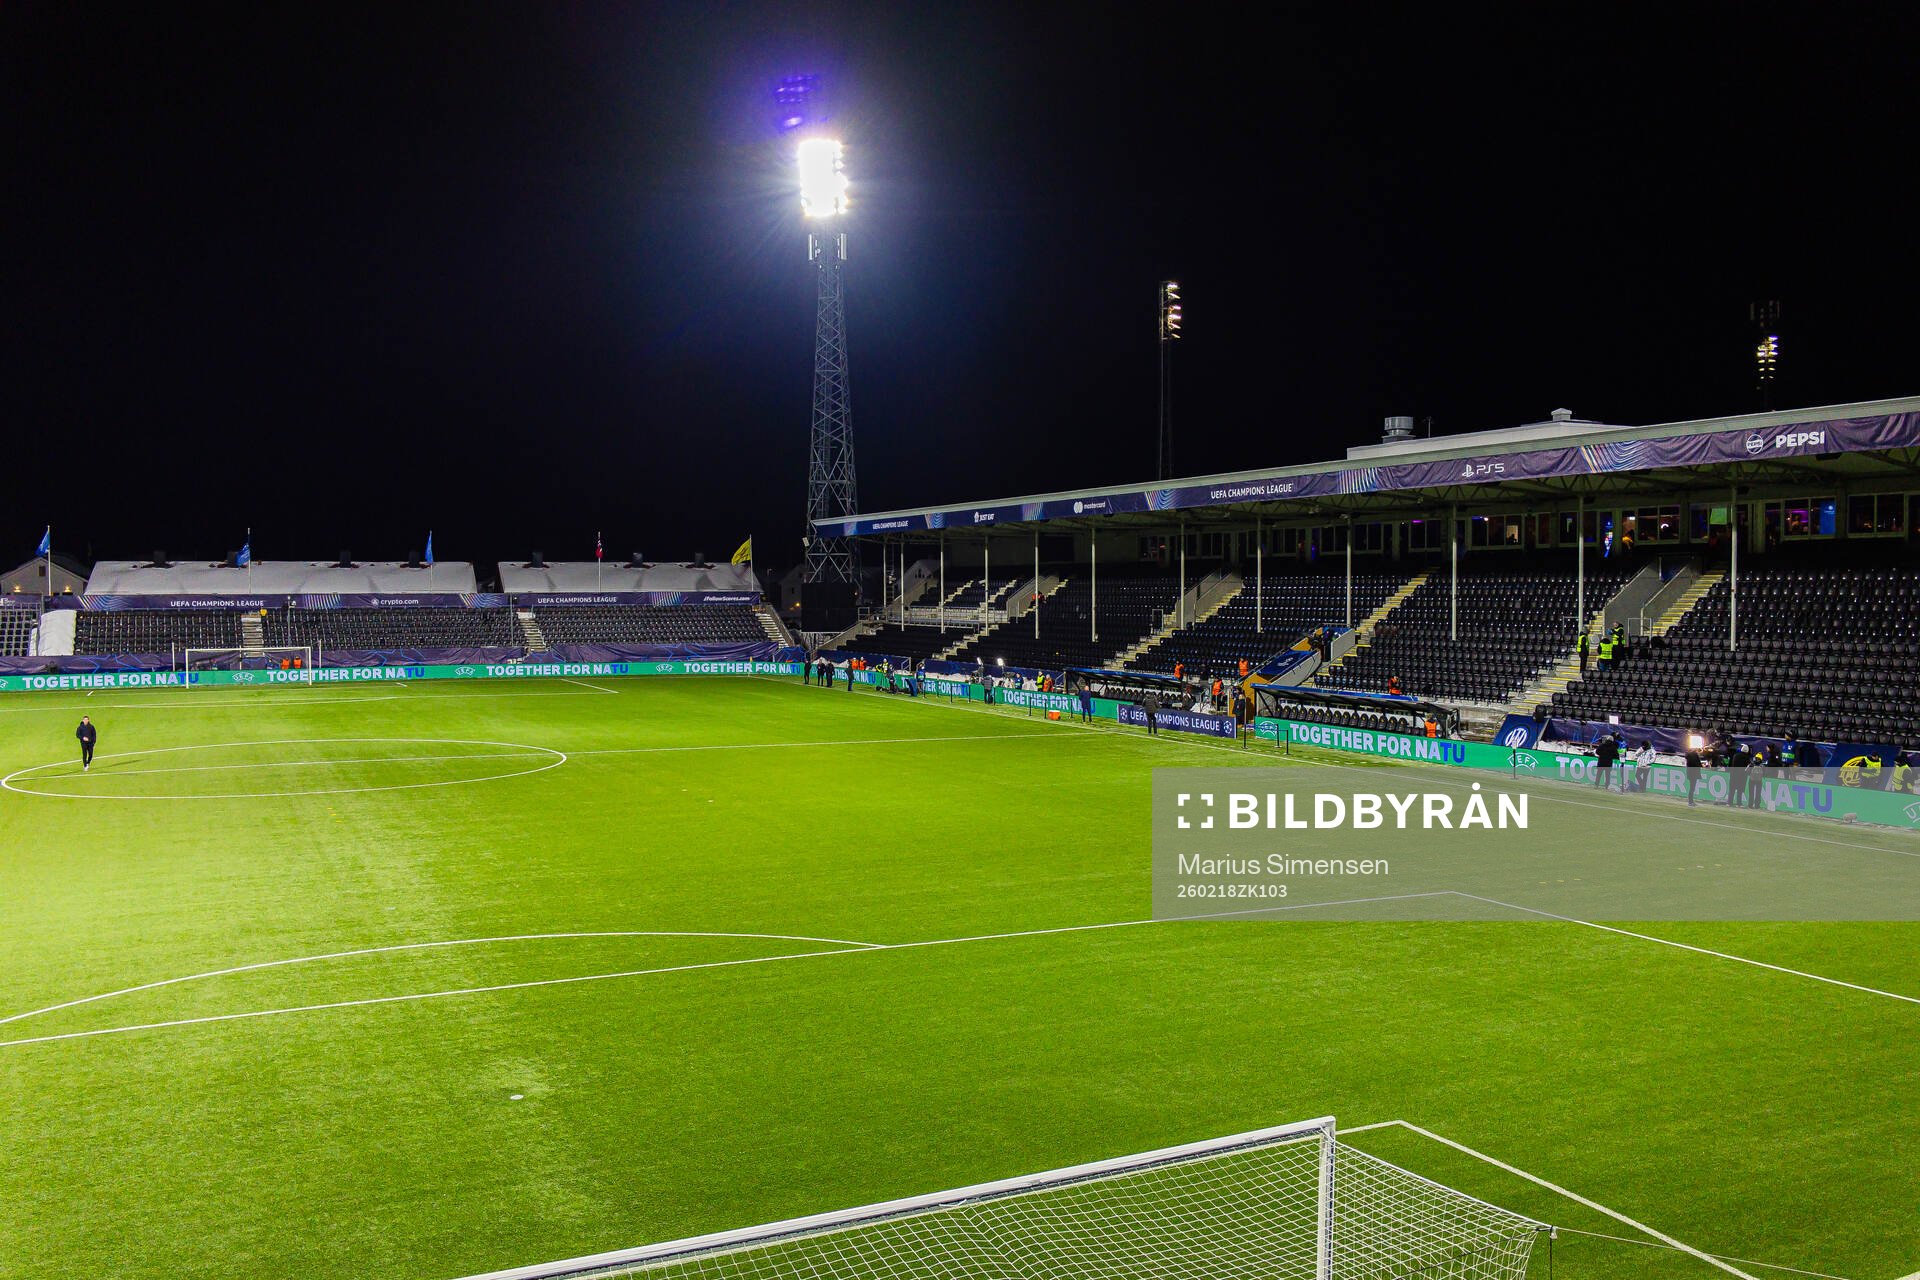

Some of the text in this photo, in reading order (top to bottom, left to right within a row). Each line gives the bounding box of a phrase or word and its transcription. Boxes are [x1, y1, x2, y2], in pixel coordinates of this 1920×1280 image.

[1776, 431, 1825, 448] PEPSI
[1476, 463, 1504, 475] PS5
[1210, 483, 1292, 499] UEFA CHAMPIONS LEAGUE
[1083, 501, 1105, 509] mastercard
[380, 598, 419, 606] crypto.com
[267, 667, 425, 682] TOGETHER FOR NATU
[486, 663, 629, 676] TOGETHER FOR NATU
[684, 663, 754, 673] TOGETHER
[755, 663, 777, 673] FOR
[778, 664, 801, 674] NATU
[22, 675, 116, 689] TOGETHER
[119, 673, 152, 686] FOR
[156, 672, 199, 684] NATU
[861, 671, 876, 684] NATU
[1003, 689, 1048, 709] TOGETHER
[1050, 694, 1069, 710] FOR
[1191, 717, 1220, 731] LEAGUE
[1290, 723, 1465, 763] TOGETHER FOR NATU
